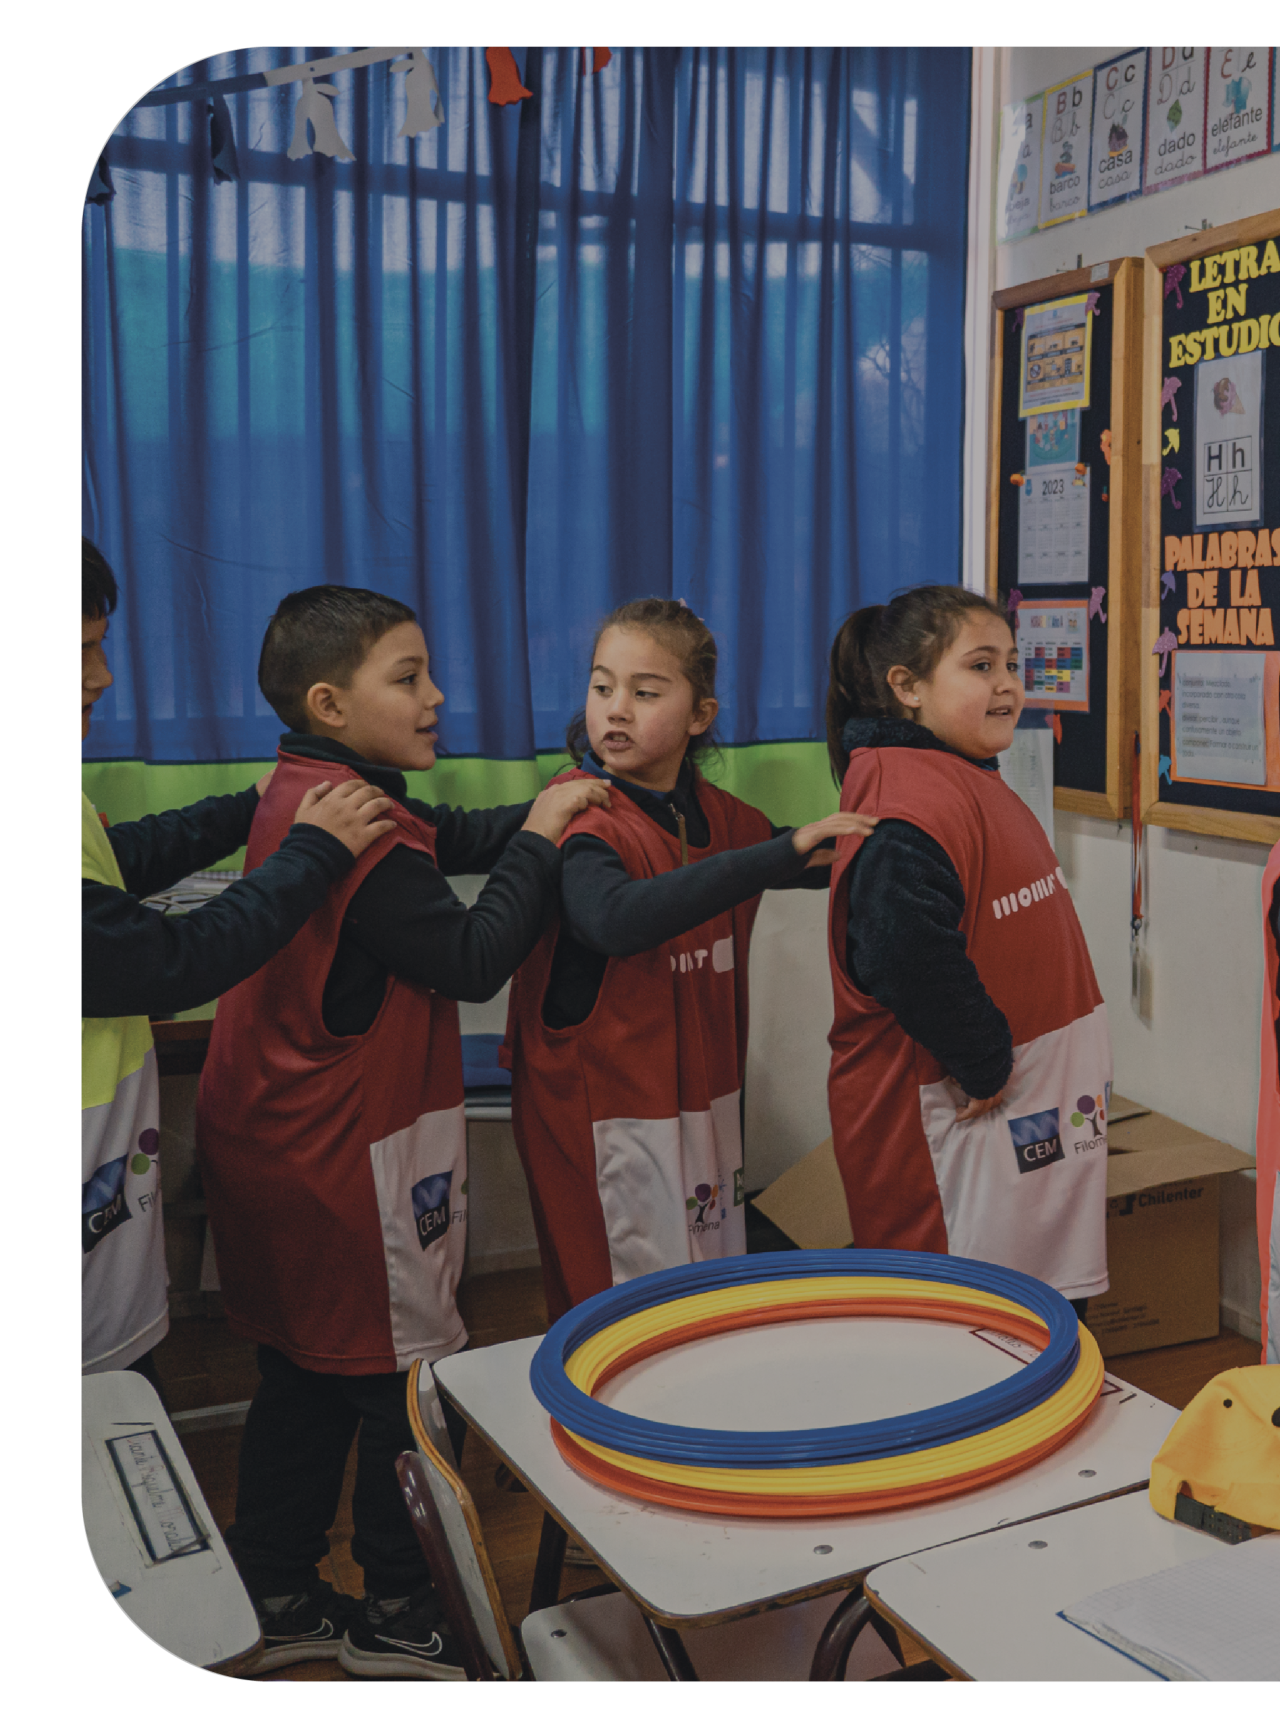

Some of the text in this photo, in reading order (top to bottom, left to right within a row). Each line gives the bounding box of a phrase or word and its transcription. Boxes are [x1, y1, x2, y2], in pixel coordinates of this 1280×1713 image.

[1105, 63, 1137, 92] C c
[1056, 87, 1083, 116] B b
[1211, 106, 1264, 138] elefante
[1158, 131, 1196, 157] dado
[1213, 132, 1259, 155] elefante
[1098, 149, 1133, 174] casa
[1154, 151, 1197, 176] dado
[1050, 176, 1080, 194] barco
[1098, 169, 1133, 190] casa
[1207, 283, 1248, 324] EN
[1207, 441, 1245, 472] H h
[1042, 479, 1065, 496] 2023
[1205, 474, 1249, 509] H h
[1187, 568, 1262, 609] DE LA
[1177, 608, 1275, 645] SEMANA
[1023, 1135, 1107, 1162] CEM Filom
[1139, 1187, 1204, 1208] Chilenter
[417, 1209, 447, 1238] CEM
